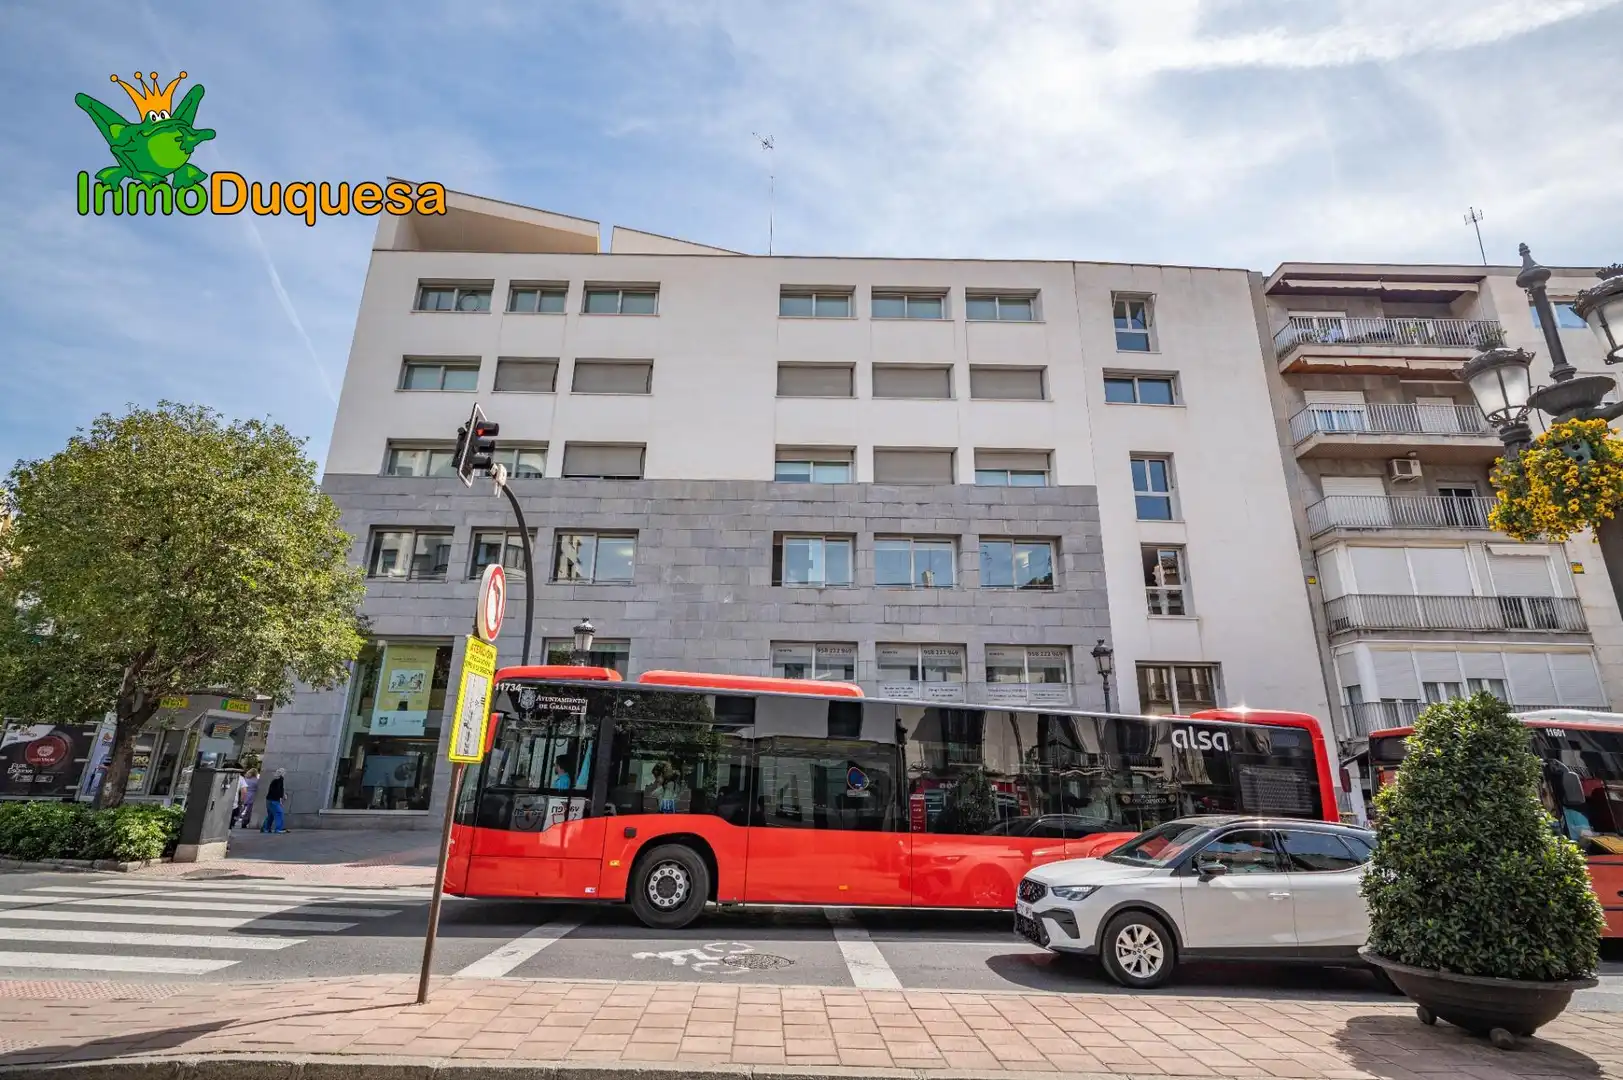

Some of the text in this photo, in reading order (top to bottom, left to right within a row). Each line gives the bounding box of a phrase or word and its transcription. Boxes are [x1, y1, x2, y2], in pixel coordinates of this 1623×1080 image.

[495, 682, 522, 692] 11734
[1171, 725, 1229, 751] alsa
[1545, 727, 1566, 738] 11601
